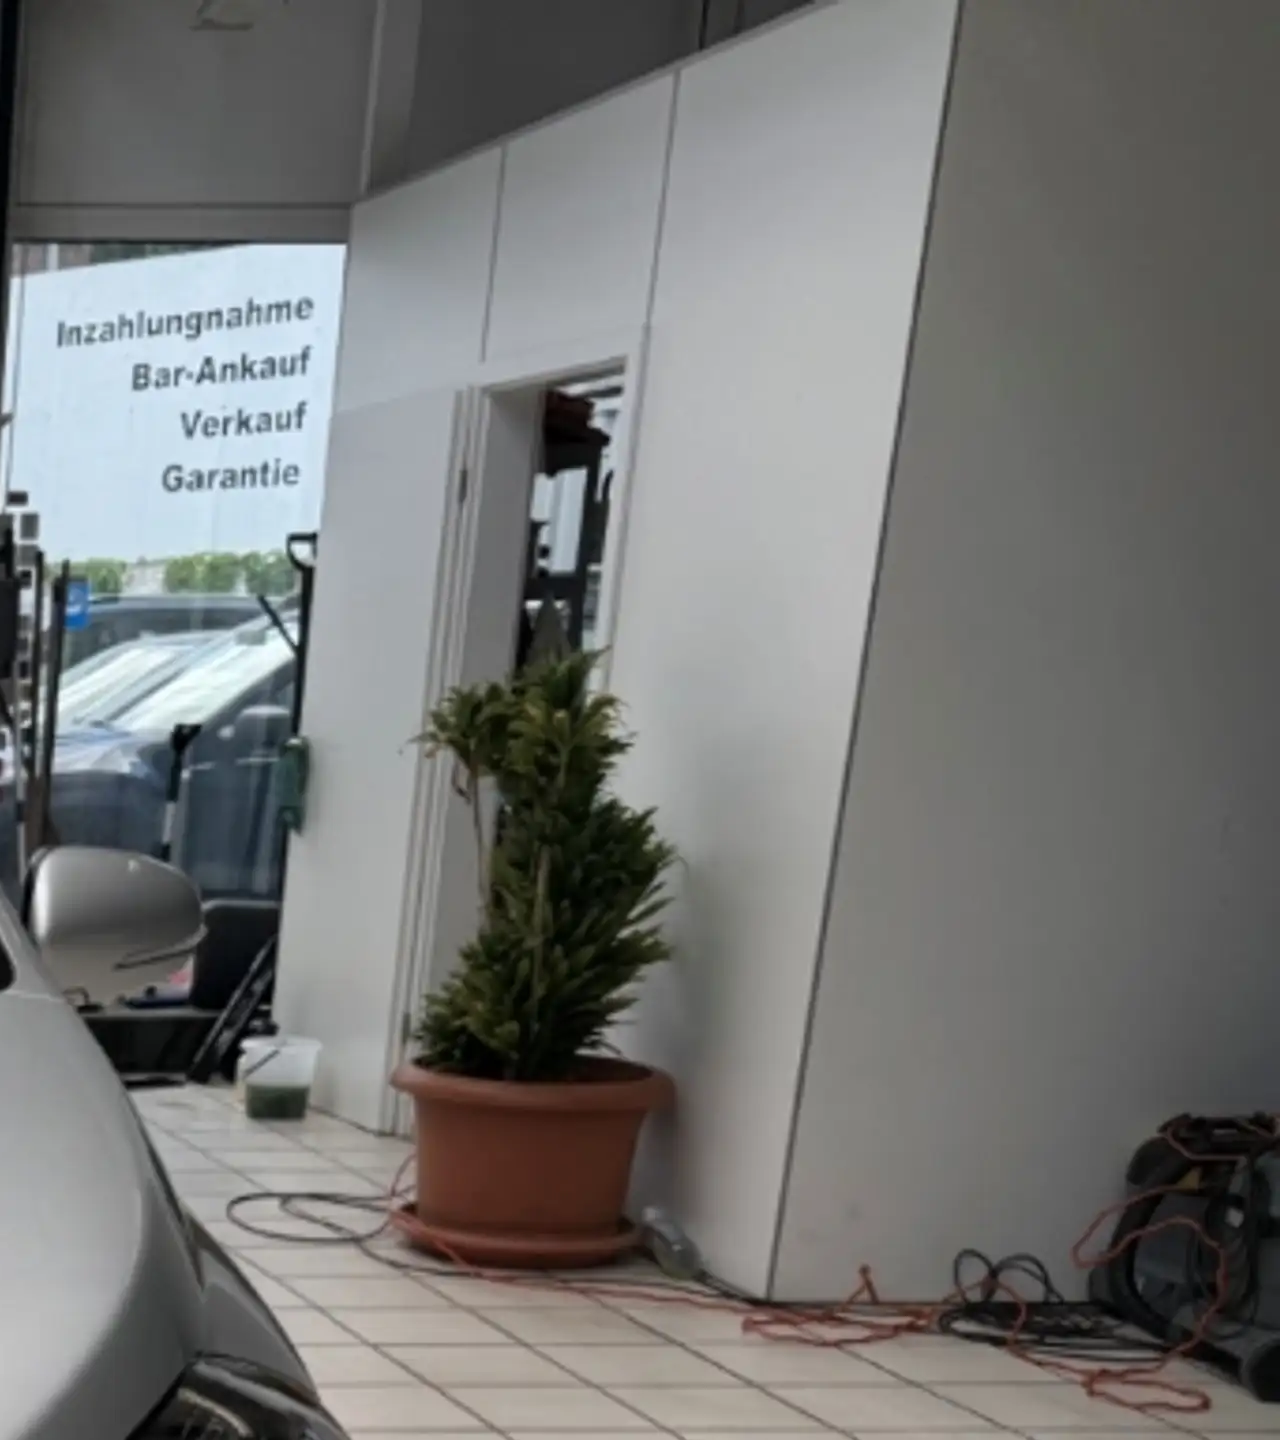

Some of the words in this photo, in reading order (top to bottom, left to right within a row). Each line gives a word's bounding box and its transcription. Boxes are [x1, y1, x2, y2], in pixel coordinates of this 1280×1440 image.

[56, 296, 315, 348] Inzahlungnahme
[131, 345, 313, 392] Bar-Ankauf
[180, 400, 308, 440] Verkauf
[161, 458, 300, 492] Garantie
